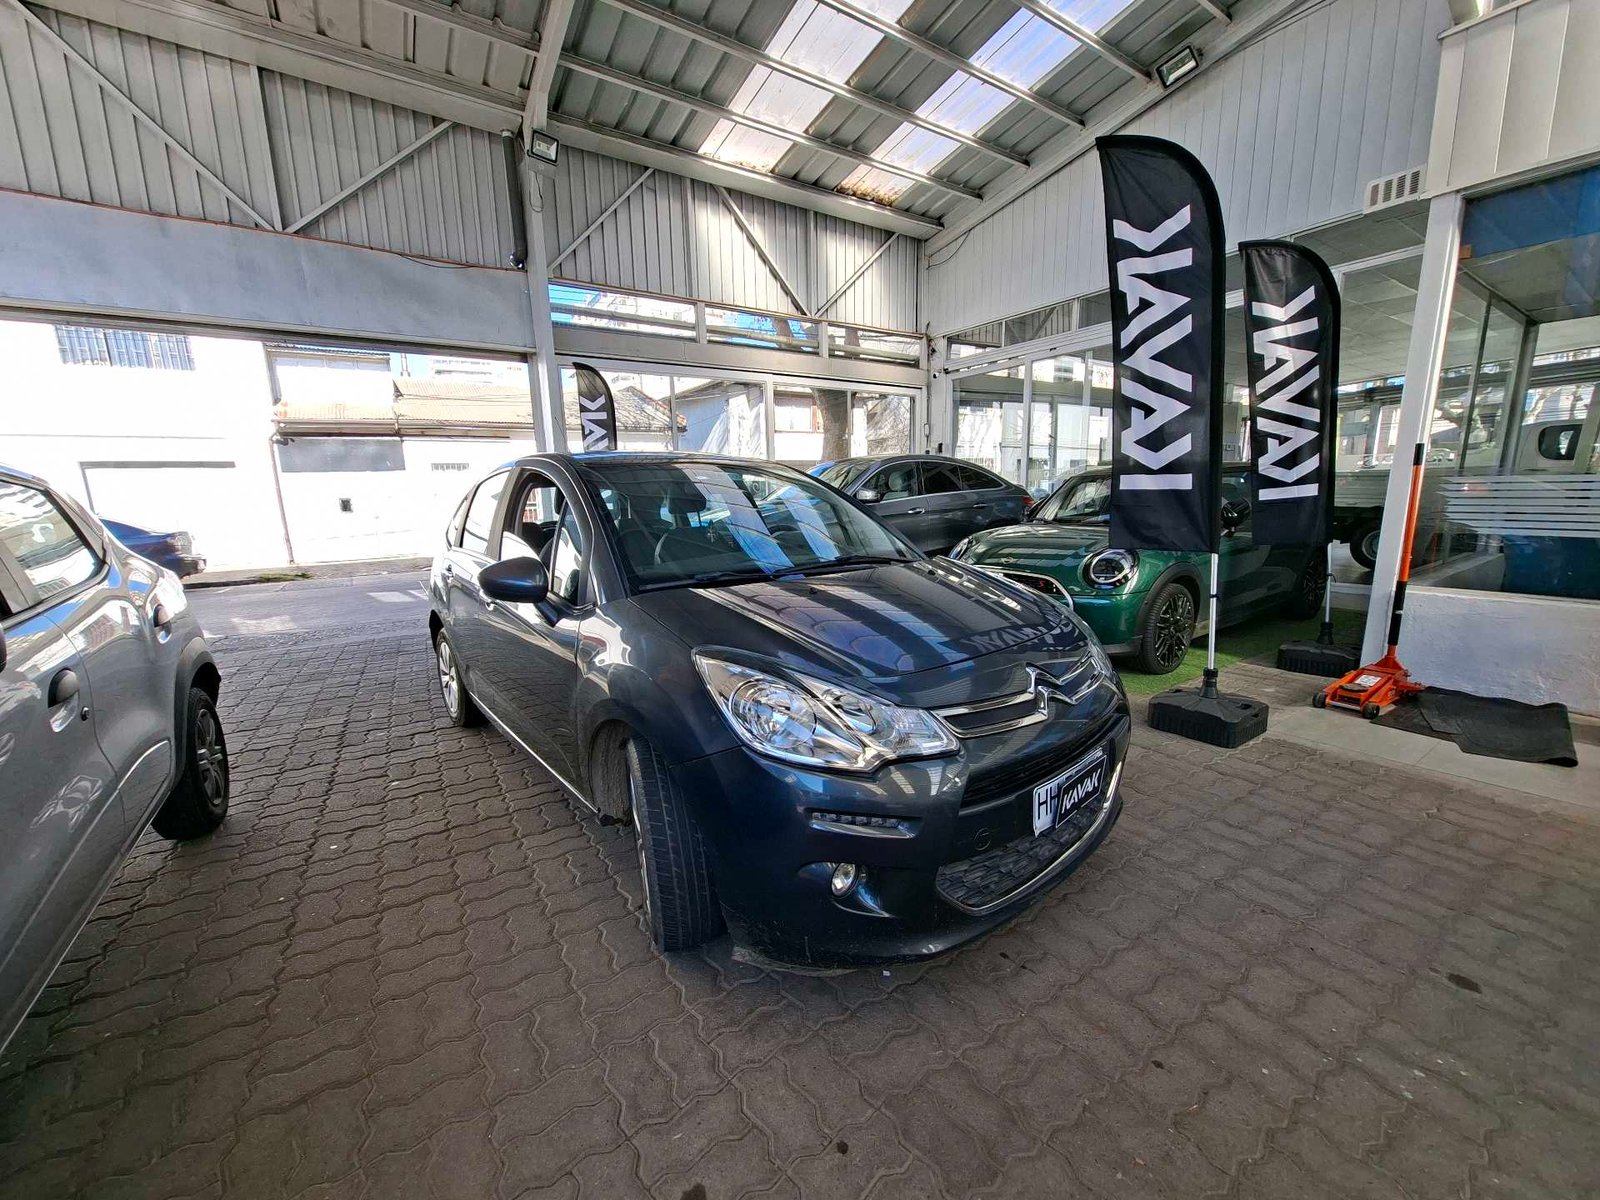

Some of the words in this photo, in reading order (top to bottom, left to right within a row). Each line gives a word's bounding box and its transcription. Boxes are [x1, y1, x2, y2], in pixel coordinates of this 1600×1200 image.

[1113, 204, 1193, 491] KAVAK
[1252, 285, 1320, 501] KAVAK
[1061, 768, 1101, 814] KAVAK
